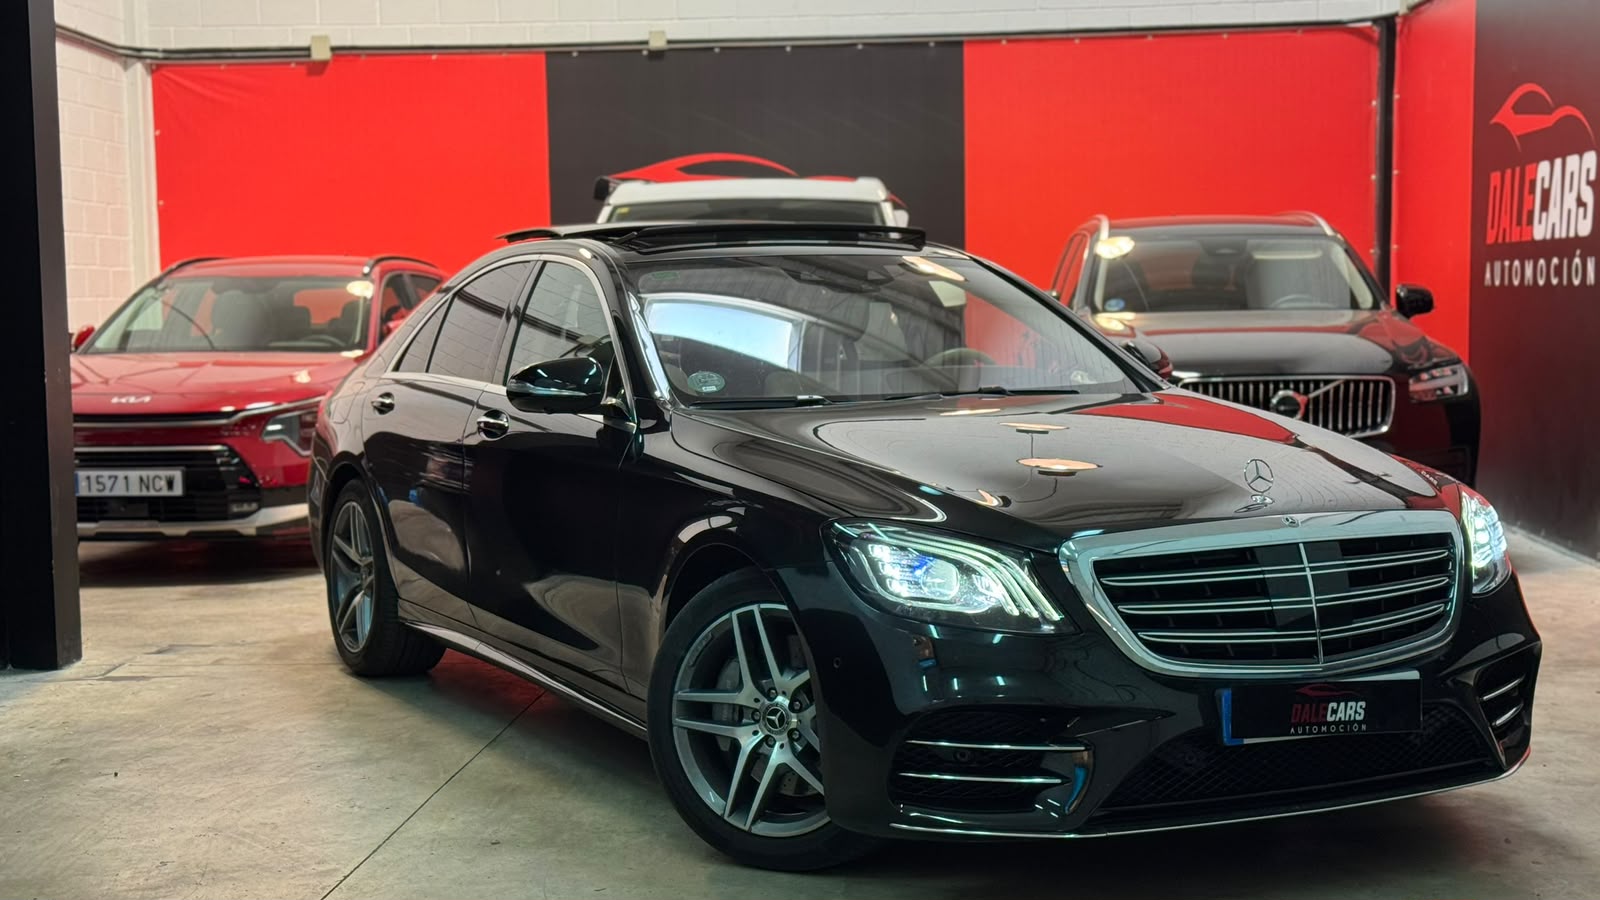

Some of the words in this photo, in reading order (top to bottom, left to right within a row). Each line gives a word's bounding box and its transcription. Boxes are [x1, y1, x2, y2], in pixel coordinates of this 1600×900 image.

[1485, 150, 1597, 245] DALECARS
[1484, 249, 1596, 287] AUTOMOCIÓN
[85, 475, 130, 493] 1571
[139, 475, 175, 493] NCW
[1291, 701, 1366, 723] DALECARS
[1290, 723, 1367, 734] AUTOMOCIÓN
